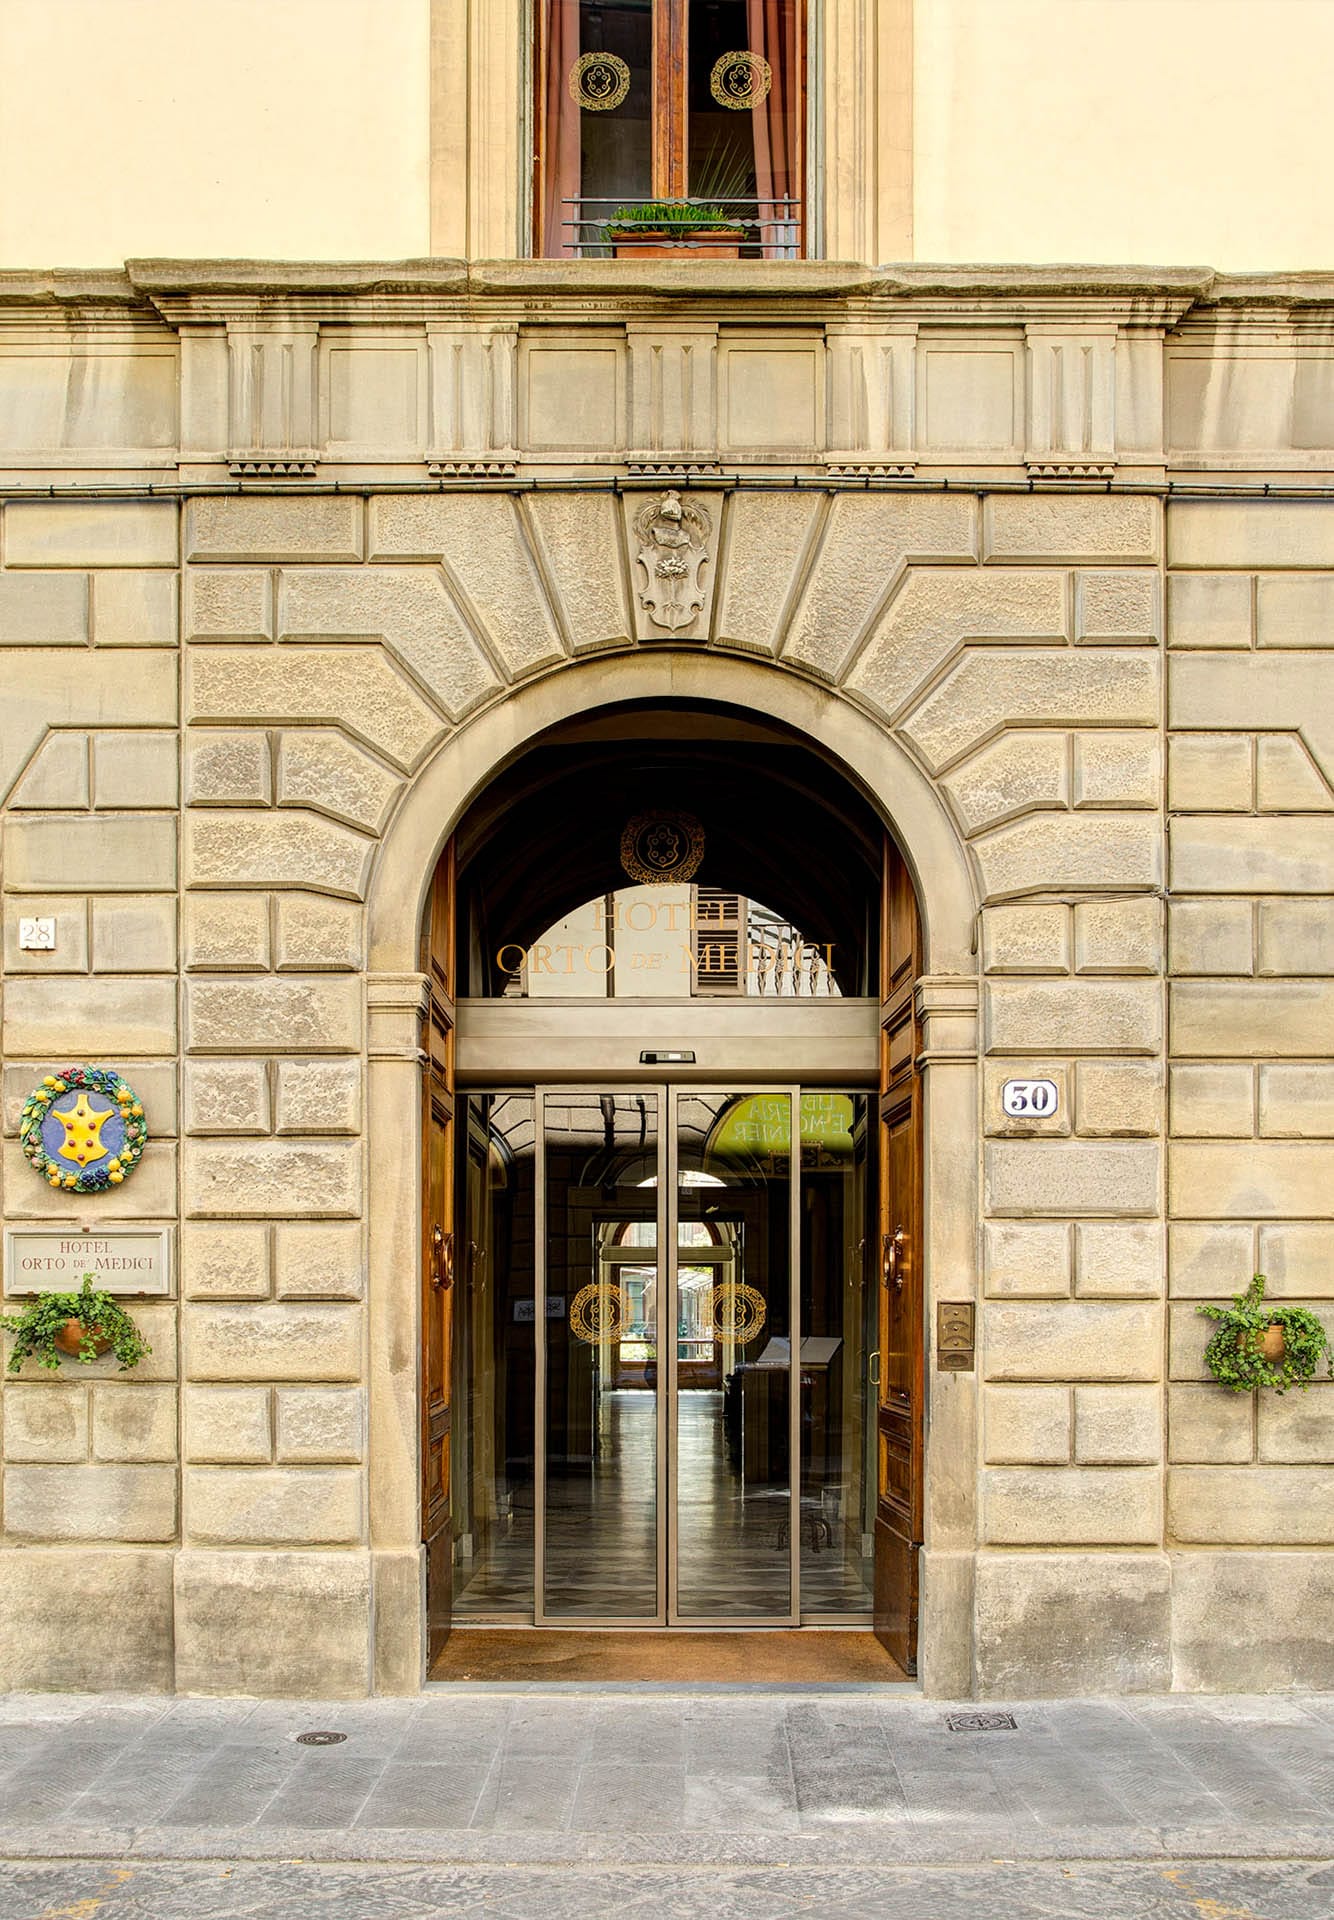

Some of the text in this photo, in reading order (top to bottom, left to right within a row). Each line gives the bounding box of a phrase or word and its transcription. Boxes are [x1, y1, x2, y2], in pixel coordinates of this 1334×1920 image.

[592, 901, 738, 931] HOTEL
[24, 924, 50, 942] 28
[496, 944, 615, 973] ORTO
[680, 943, 836, 973] MEDICI
[1011, 1086, 1048, 1111] 30
[60, 1241, 112, 1254] HOTEL
[22, 1257, 66, 1270] ORTO
[95, 1257, 153, 1270] MEDICI
